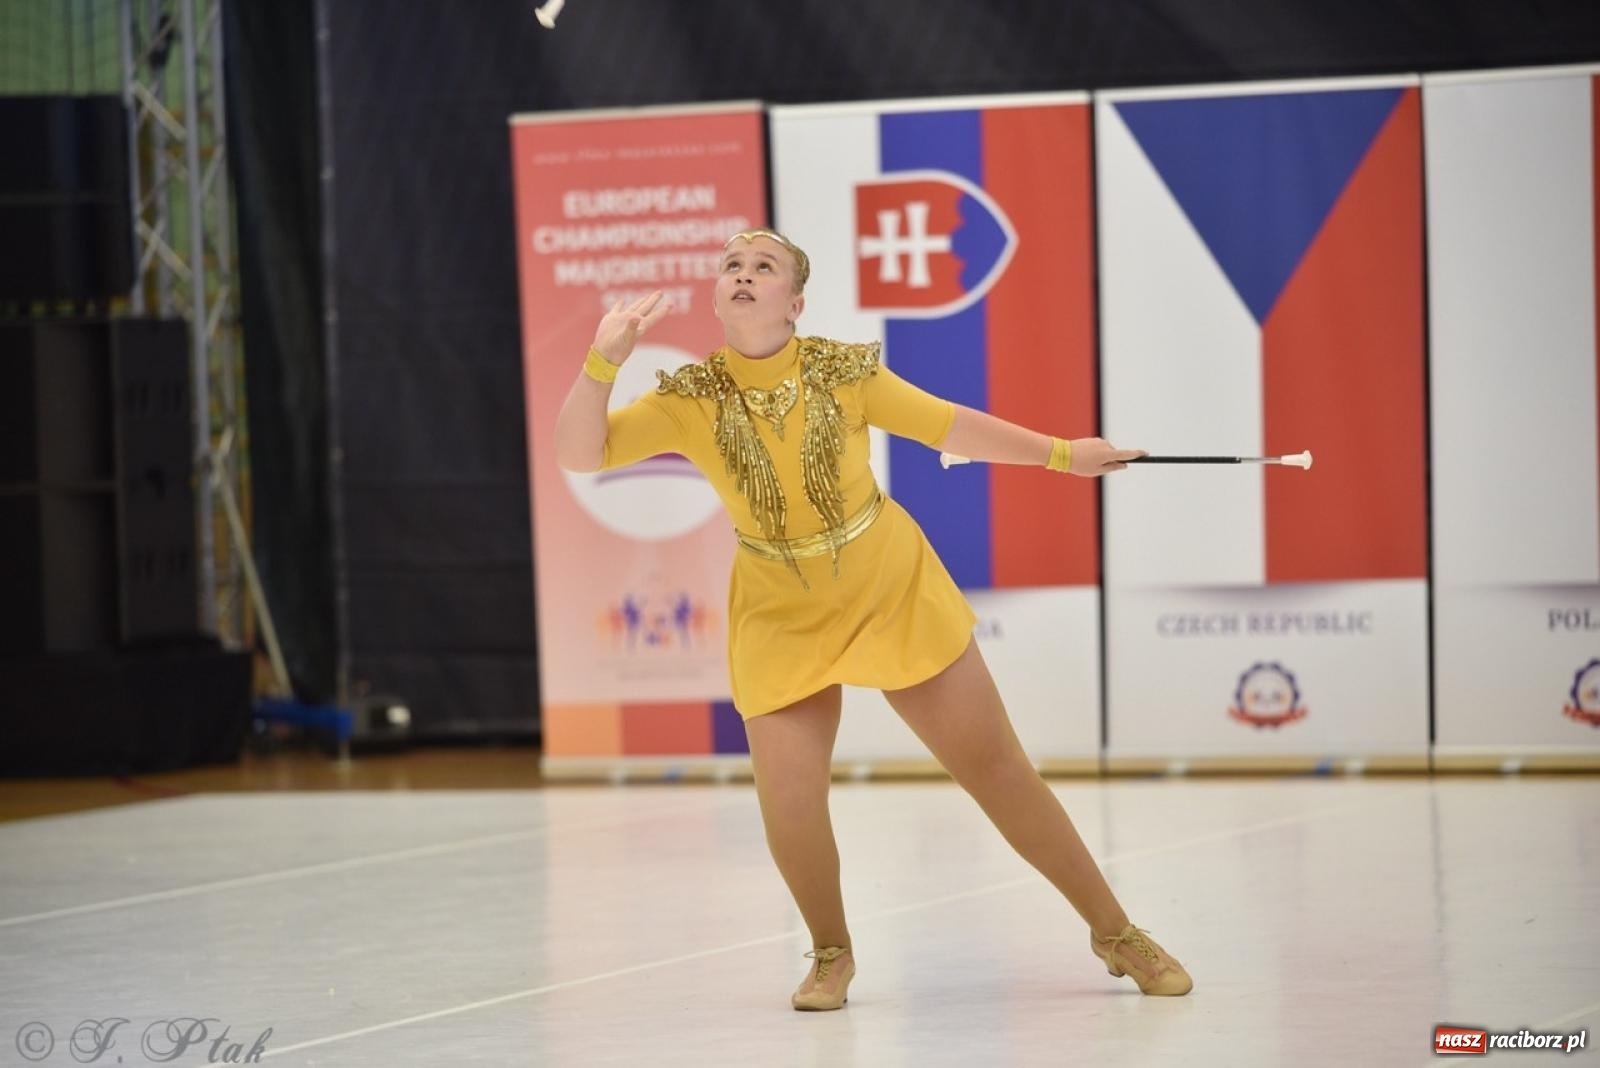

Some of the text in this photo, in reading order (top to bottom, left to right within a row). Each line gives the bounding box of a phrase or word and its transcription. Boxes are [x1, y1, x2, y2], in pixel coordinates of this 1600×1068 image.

[563, 184, 716, 218] EUROPEAN
[1157, 609, 1373, 637] CZECH REPUBLIC
